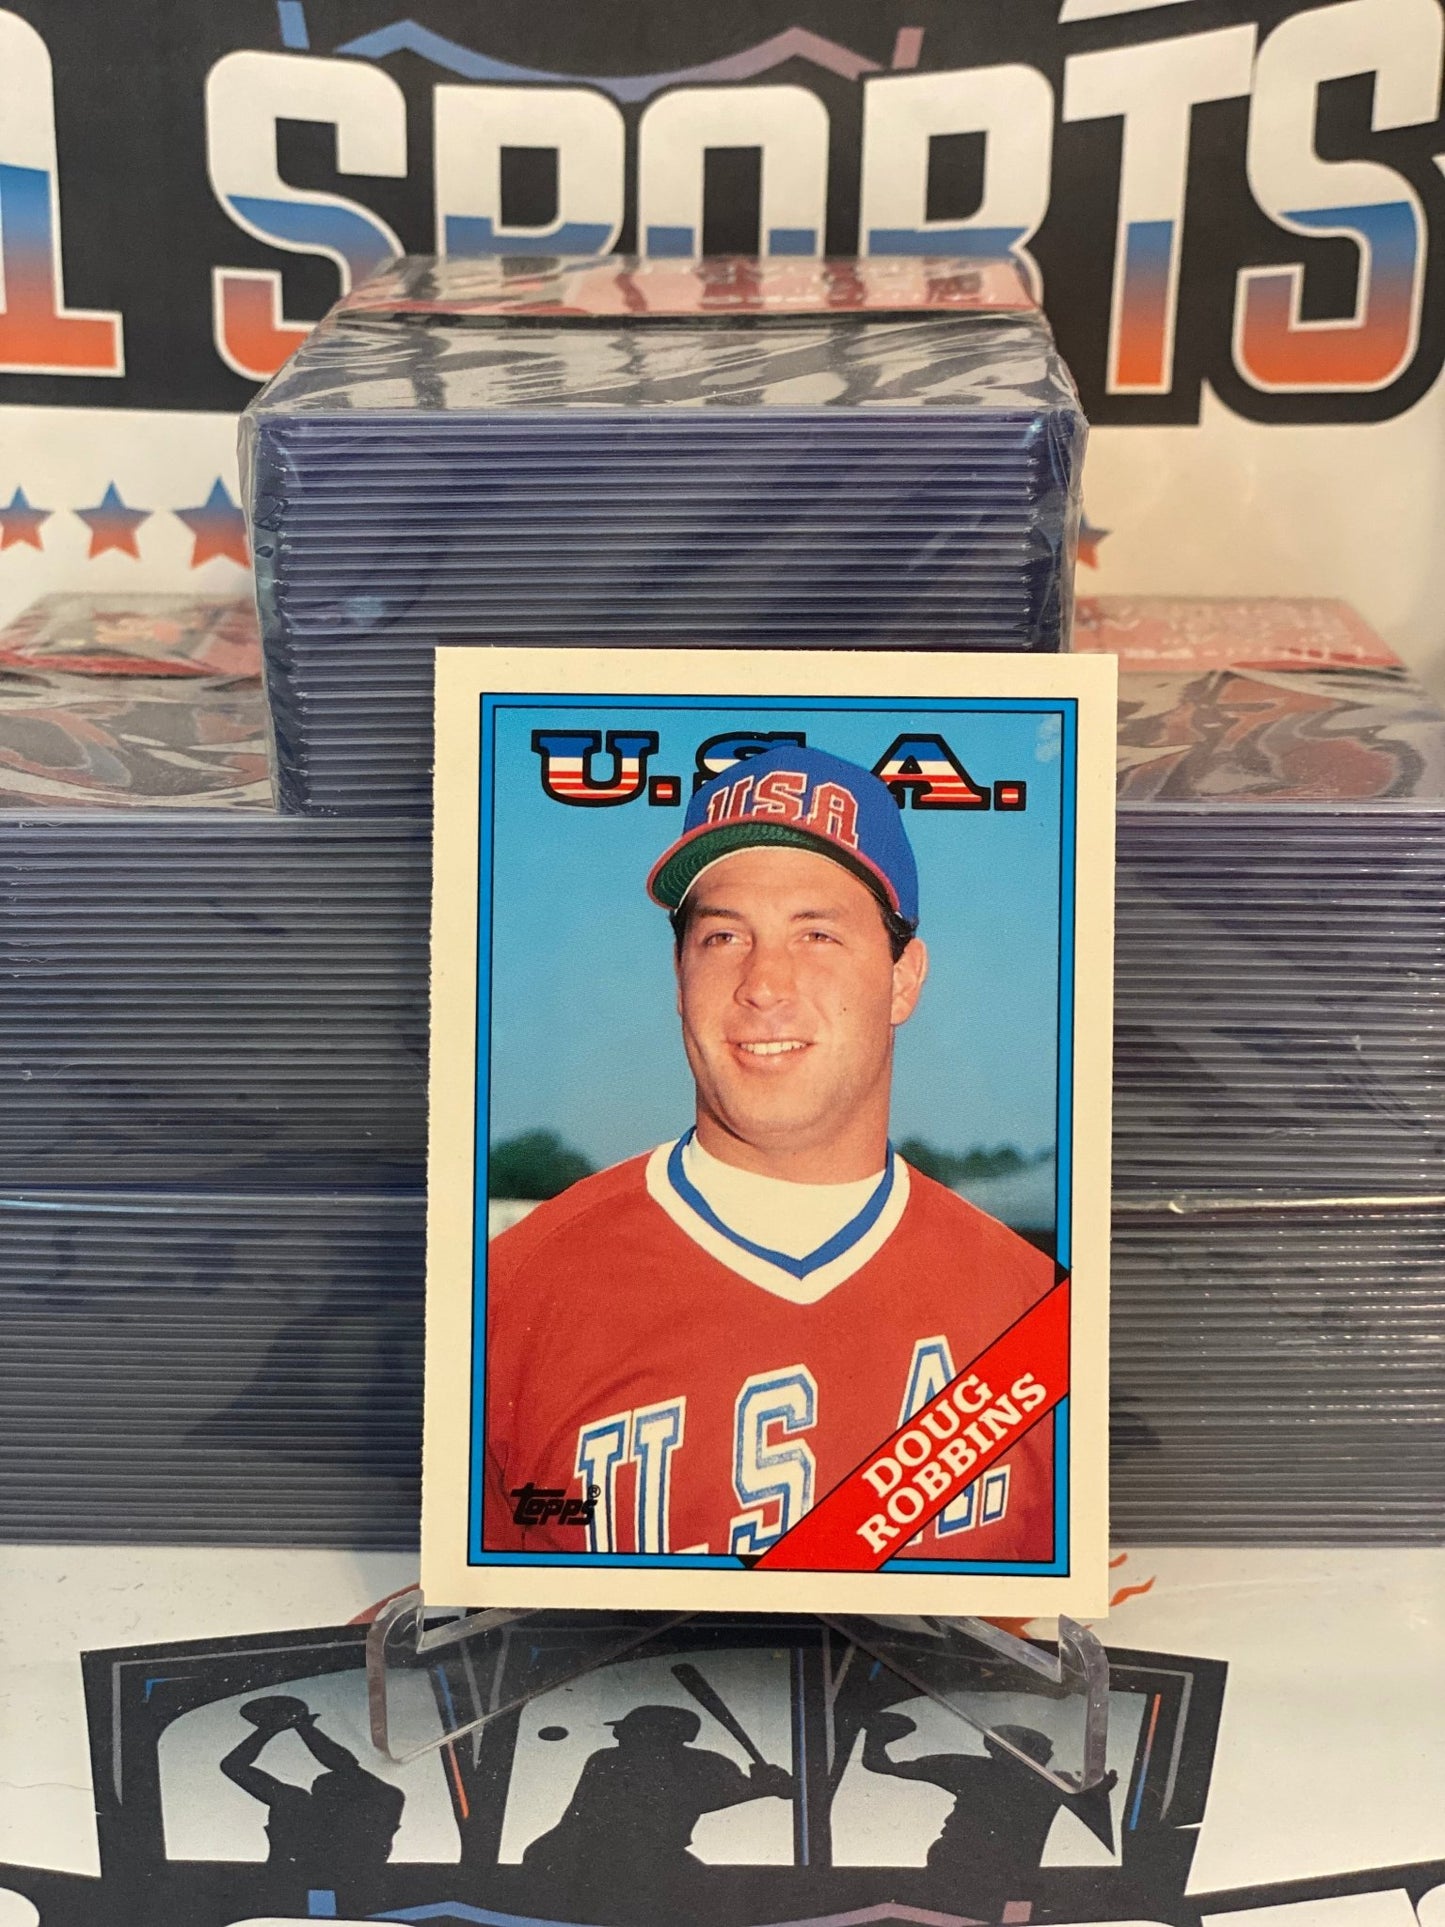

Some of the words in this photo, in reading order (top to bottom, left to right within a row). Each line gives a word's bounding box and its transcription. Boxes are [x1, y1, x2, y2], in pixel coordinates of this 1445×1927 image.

[204, 0, 1445, 396] SPORTS
[530, 728, 1027, 812] U.A.
[855, 1371, 1047, 1554] ROBBINS
[861, 1373, 994, 1499] DOUG
